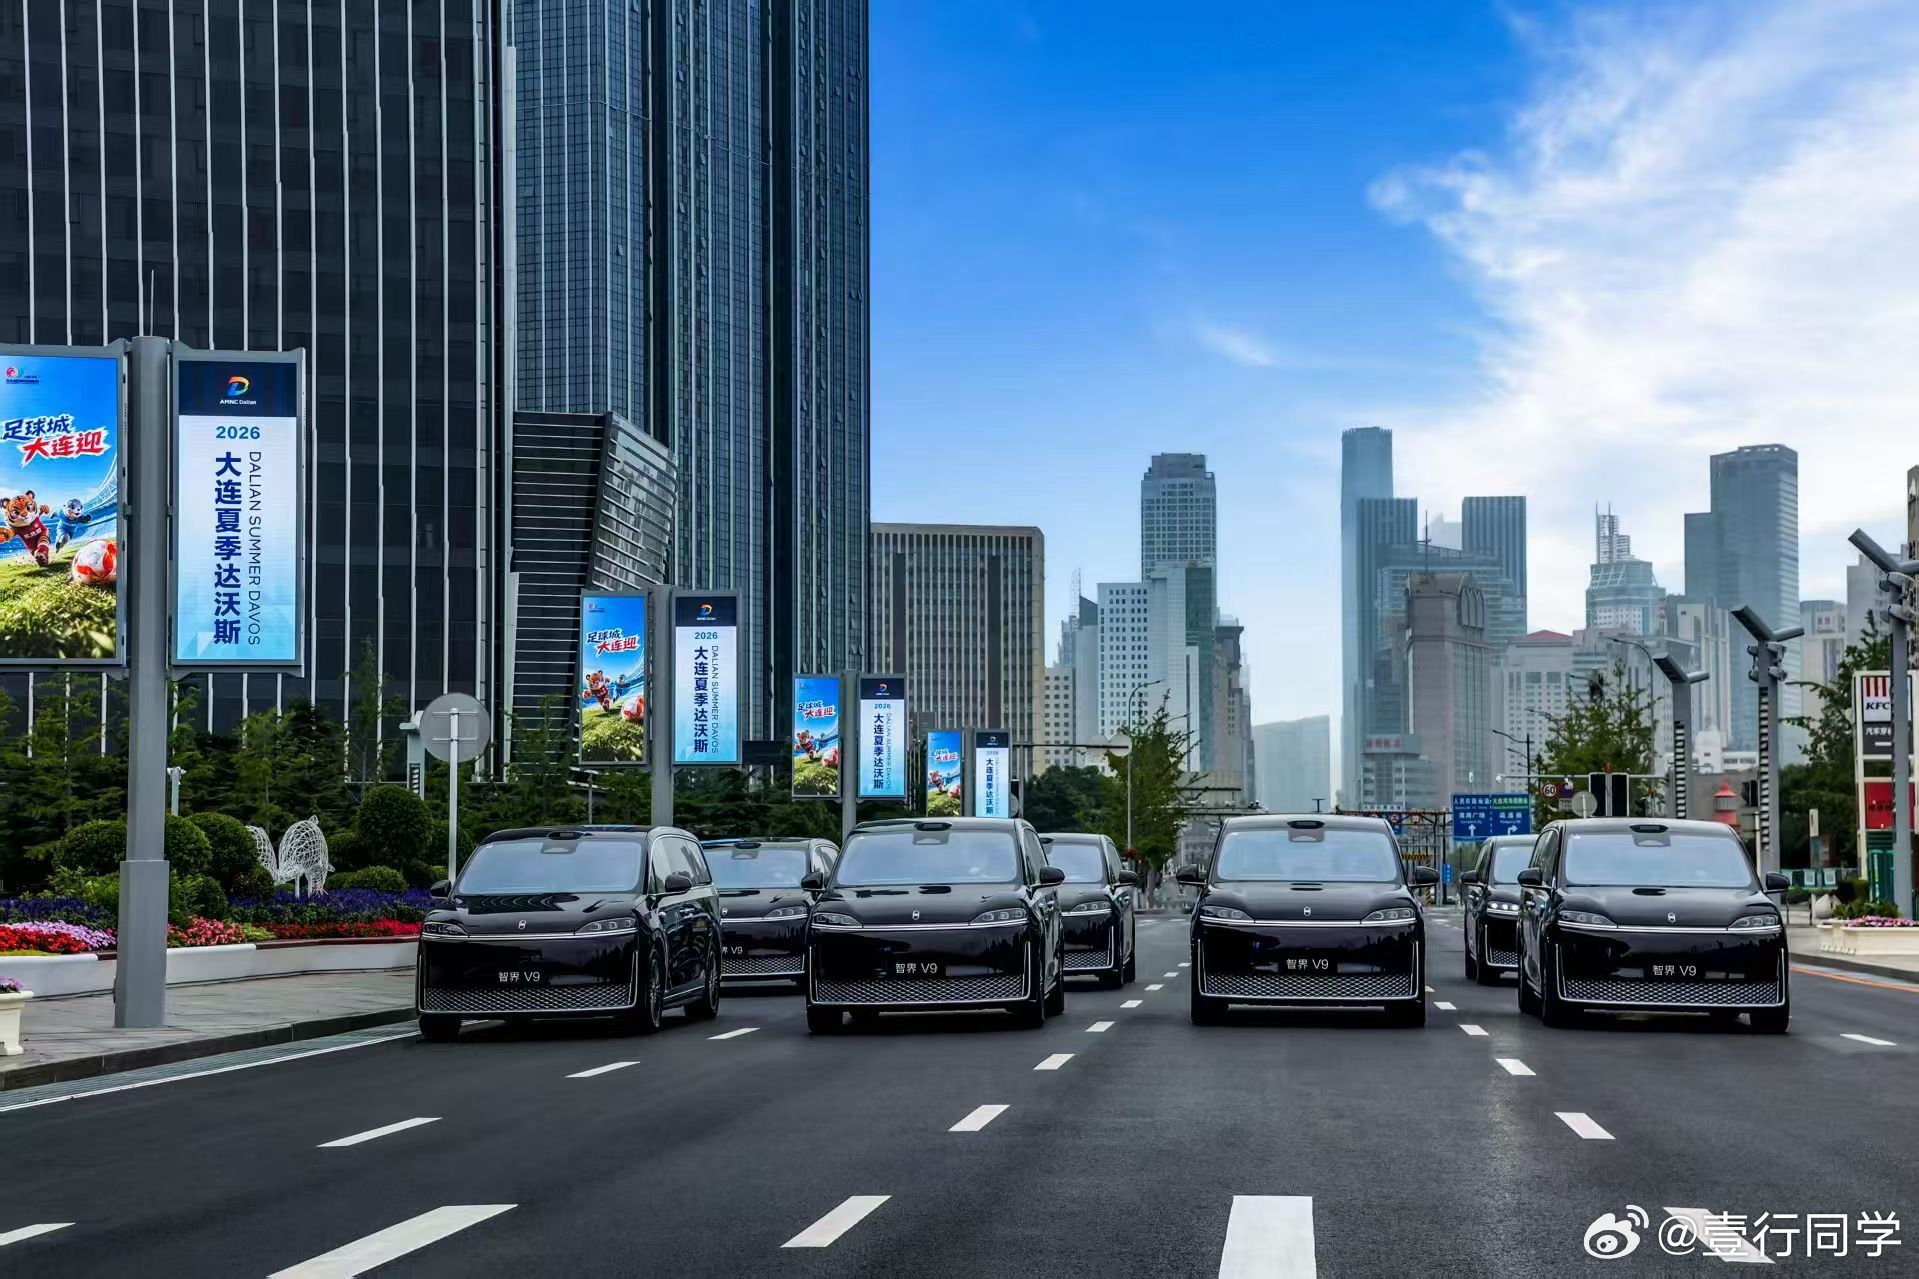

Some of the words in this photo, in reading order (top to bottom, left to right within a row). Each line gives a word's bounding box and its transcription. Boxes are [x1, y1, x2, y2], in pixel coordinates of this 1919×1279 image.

[3, 415, 71, 441] 足球城
[216, 426, 260, 439] 2026
[23, 431, 104, 463] 大连迎
[249, 451, 261, 511] DALIAN
[214, 451, 242, 644] 大连夏季达沃斯
[249, 515, 261, 586] SUMMER
[248, 590, 261, 645] DAVOS
[587, 629, 621, 643] 足球城
[694, 632, 718, 640] 2026
[597, 637, 638, 654] 大连迎
[694, 646, 708, 753] 大连夏季达沃斯
[1865, 702, 1890, 710] KFC
[873, 713, 884, 789] 大连夏季达沃斯
[1544, 786, 1556, 795] 60
[731, 946, 743, 954] V9
[895, 962, 917, 973] 智界
[921, 963, 937, 974] V9
[1287, 958, 1308, 970] 智界
[1312, 959, 1328, 970] V9
[1653, 965, 1675, 976] 智界
[1680, 965, 1696, 976] V9
[499, 971, 520, 982] 智界
[524, 971, 540, 982] V9
